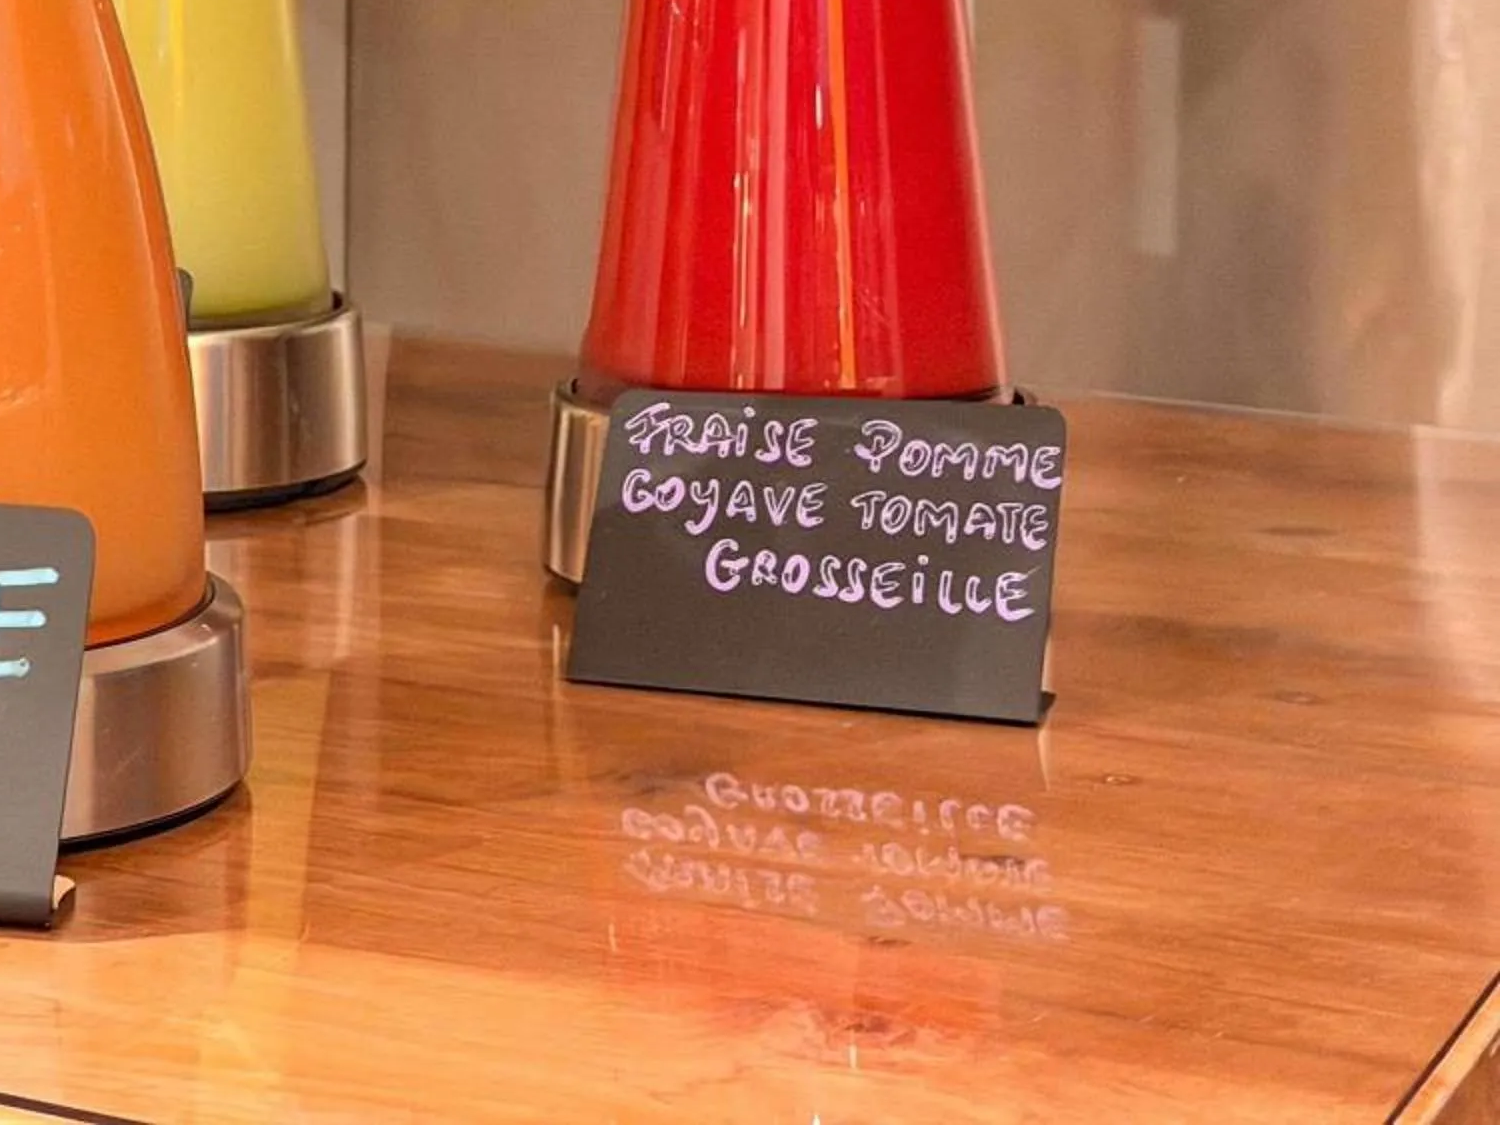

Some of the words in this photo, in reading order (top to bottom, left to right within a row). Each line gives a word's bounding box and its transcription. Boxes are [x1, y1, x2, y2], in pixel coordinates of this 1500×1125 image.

[854, 420, 1062, 489] POMME
[622, 468, 827, 535] GOYAVE
[851, 489, 1049, 551] TOMATE
